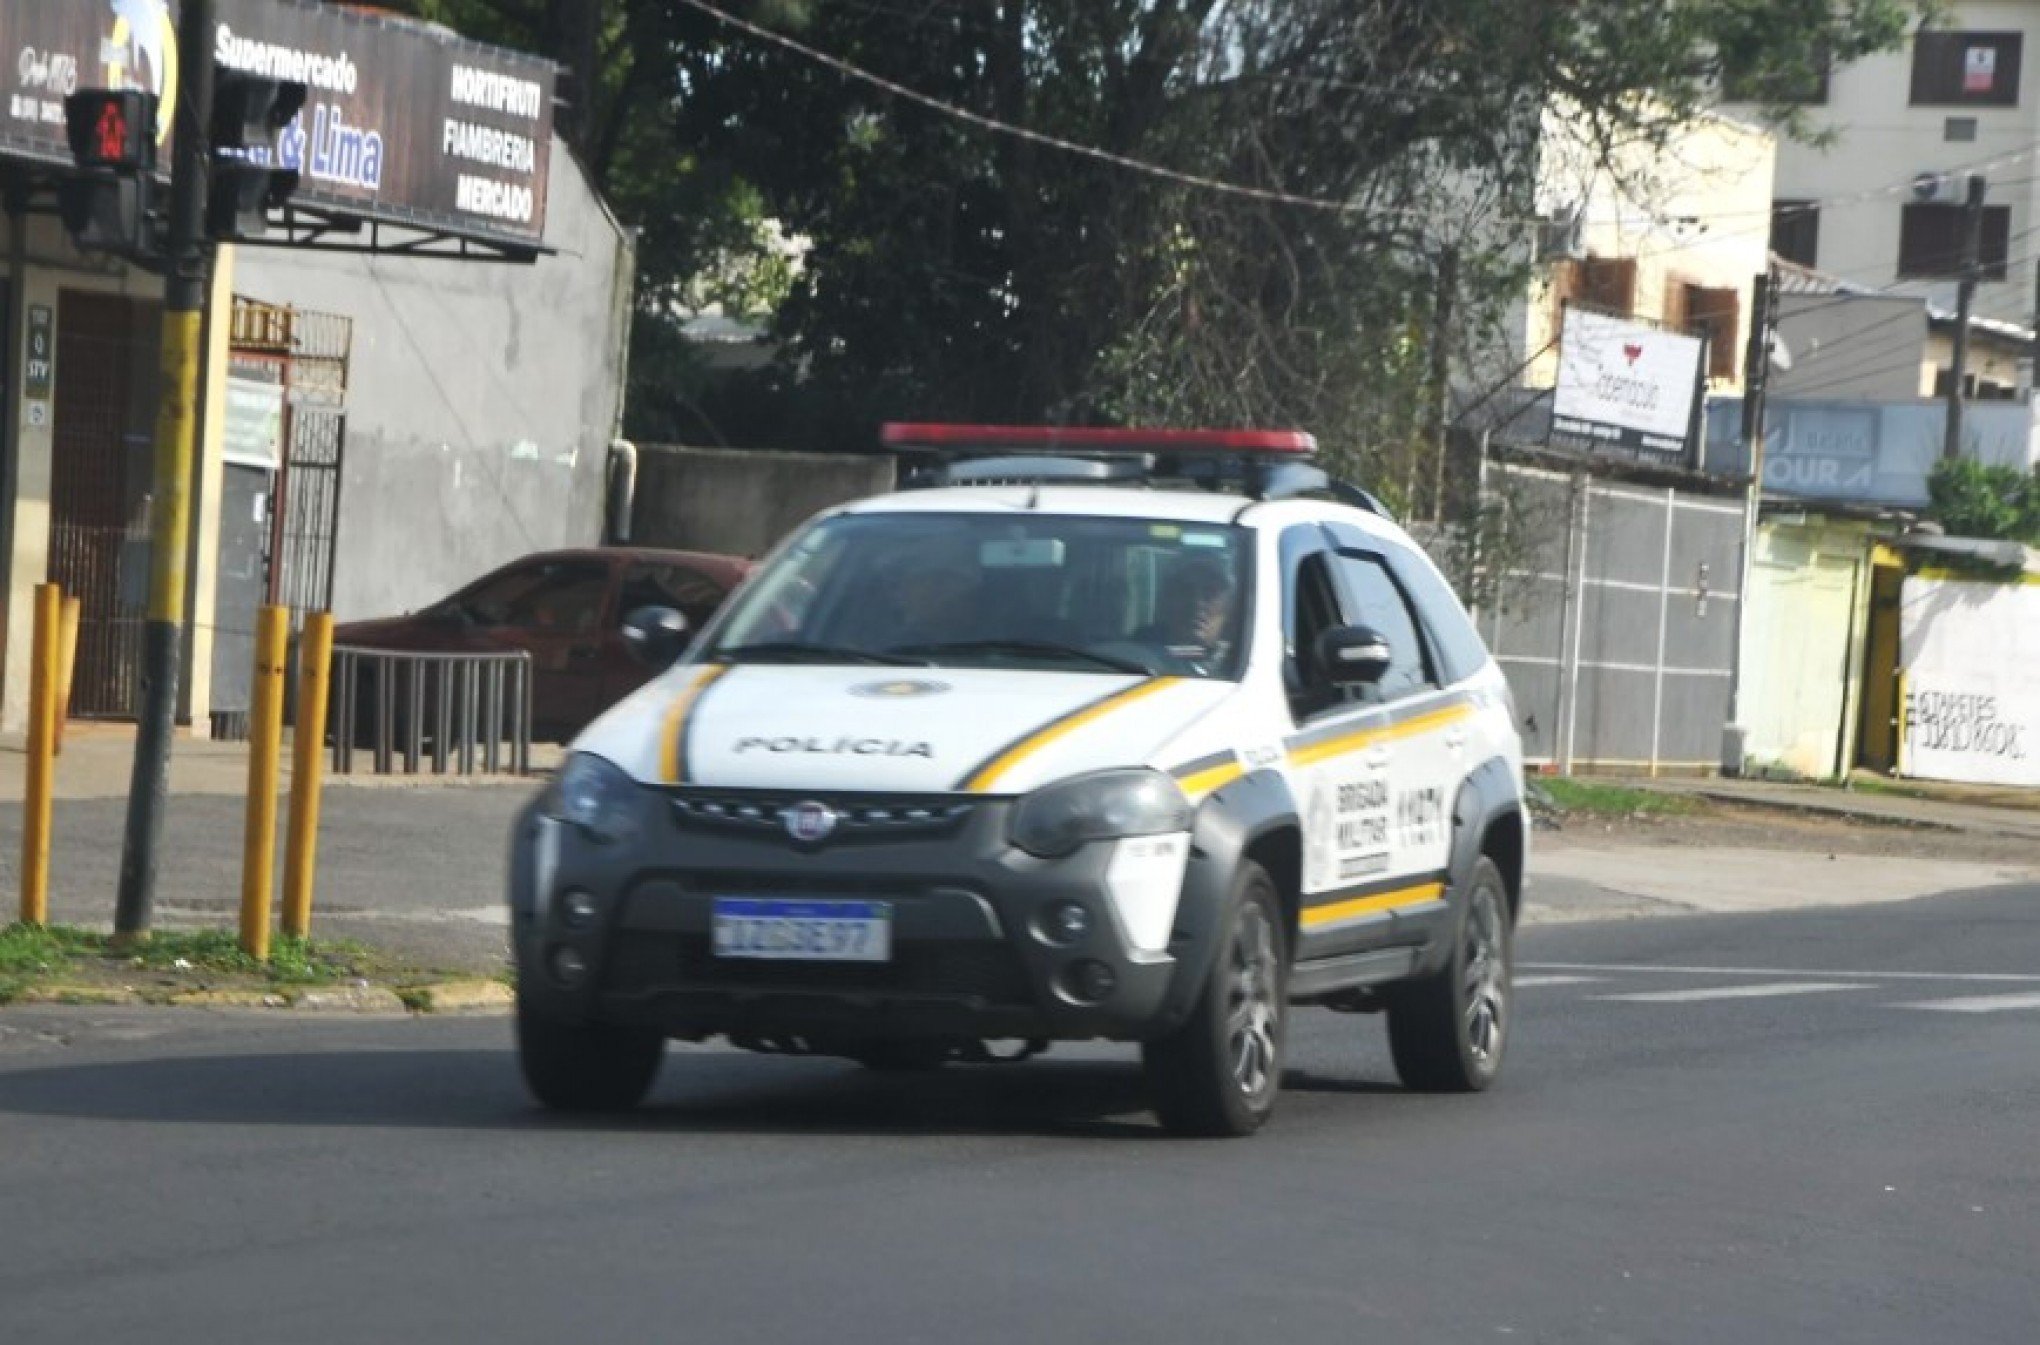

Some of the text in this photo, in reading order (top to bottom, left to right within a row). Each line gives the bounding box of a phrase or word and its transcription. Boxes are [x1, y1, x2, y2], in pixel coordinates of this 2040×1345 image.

[215, 22, 357, 94] Supermercado
[452, 64, 541, 119] HORTIFRUTI
[310, 102, 383, 190] Lima
[443, 118, 535, 173] FIAMBRERIA
[455, 173, 533, 223] MERCADO
[1338, 778, 1388, 812] BRIGADA
[1337, 816, 1387, 850] MILITAR
